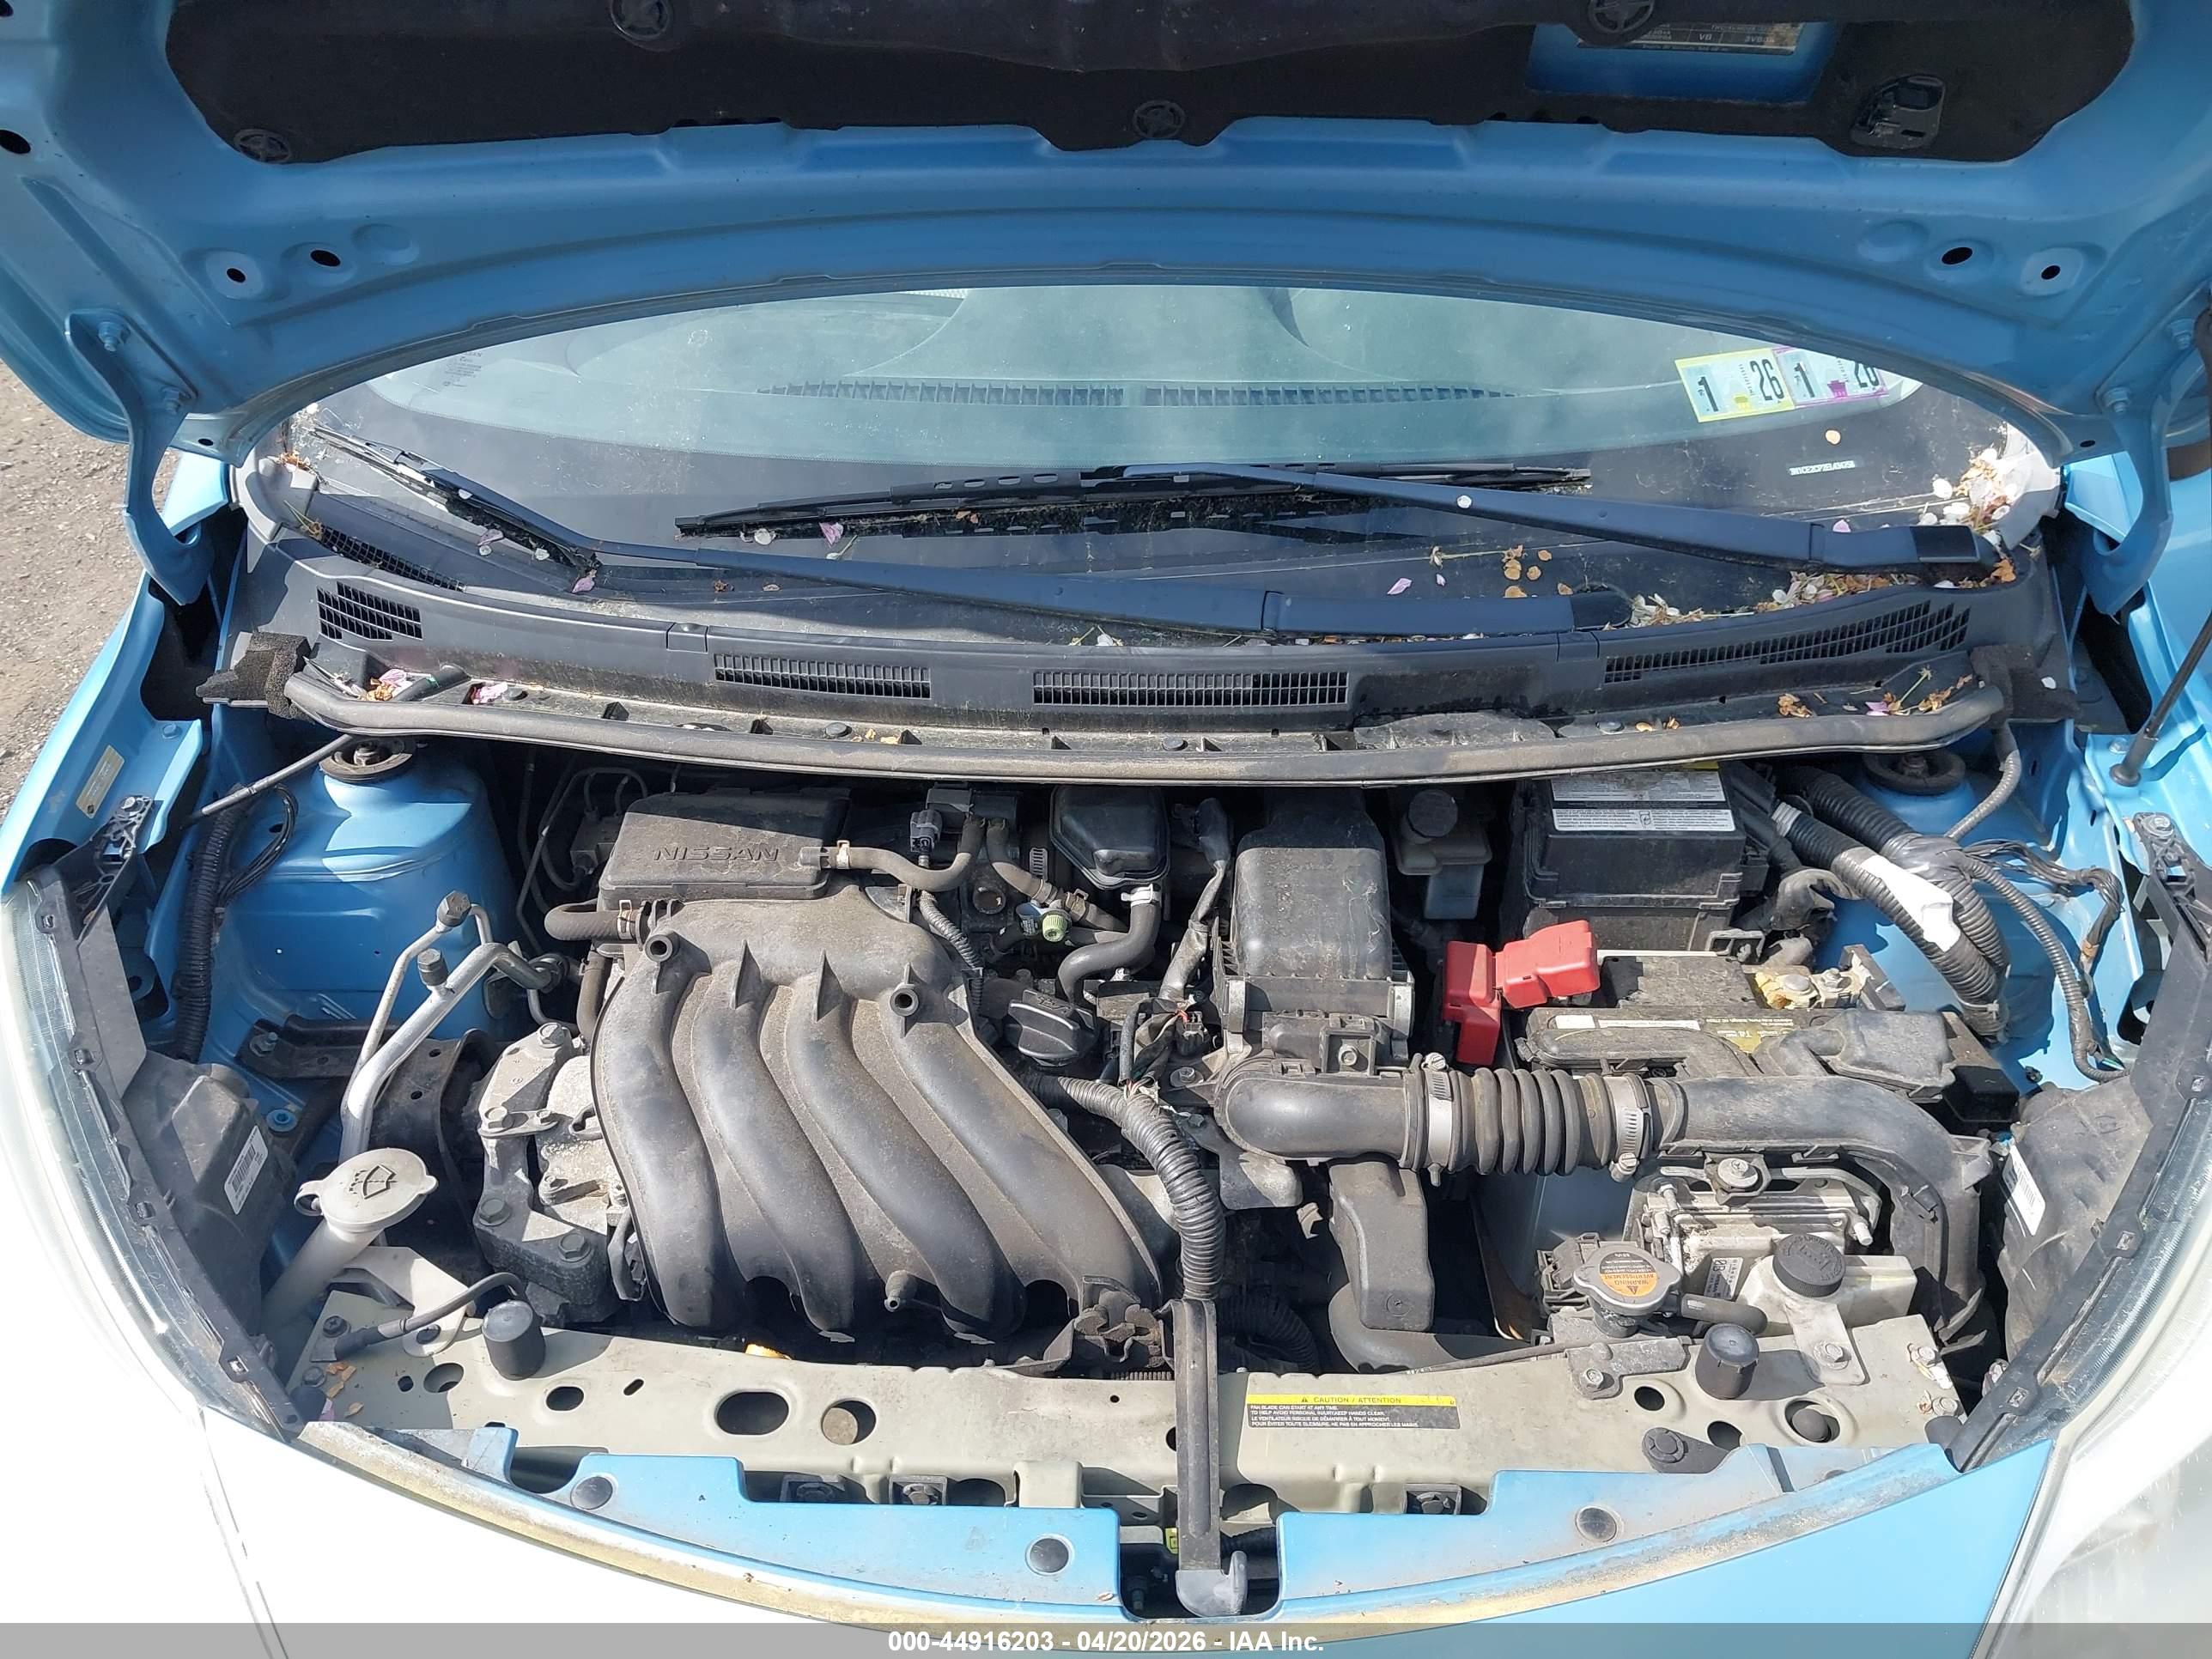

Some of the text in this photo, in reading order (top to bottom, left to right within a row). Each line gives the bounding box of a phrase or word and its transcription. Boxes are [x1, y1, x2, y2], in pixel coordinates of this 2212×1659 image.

[1697, 376, 1719, 412] 1
[1749, 358, 1784, 401] 26
[1794, 362, 1815, 398] 1
[653, 847, 779, 861] NISSAN
